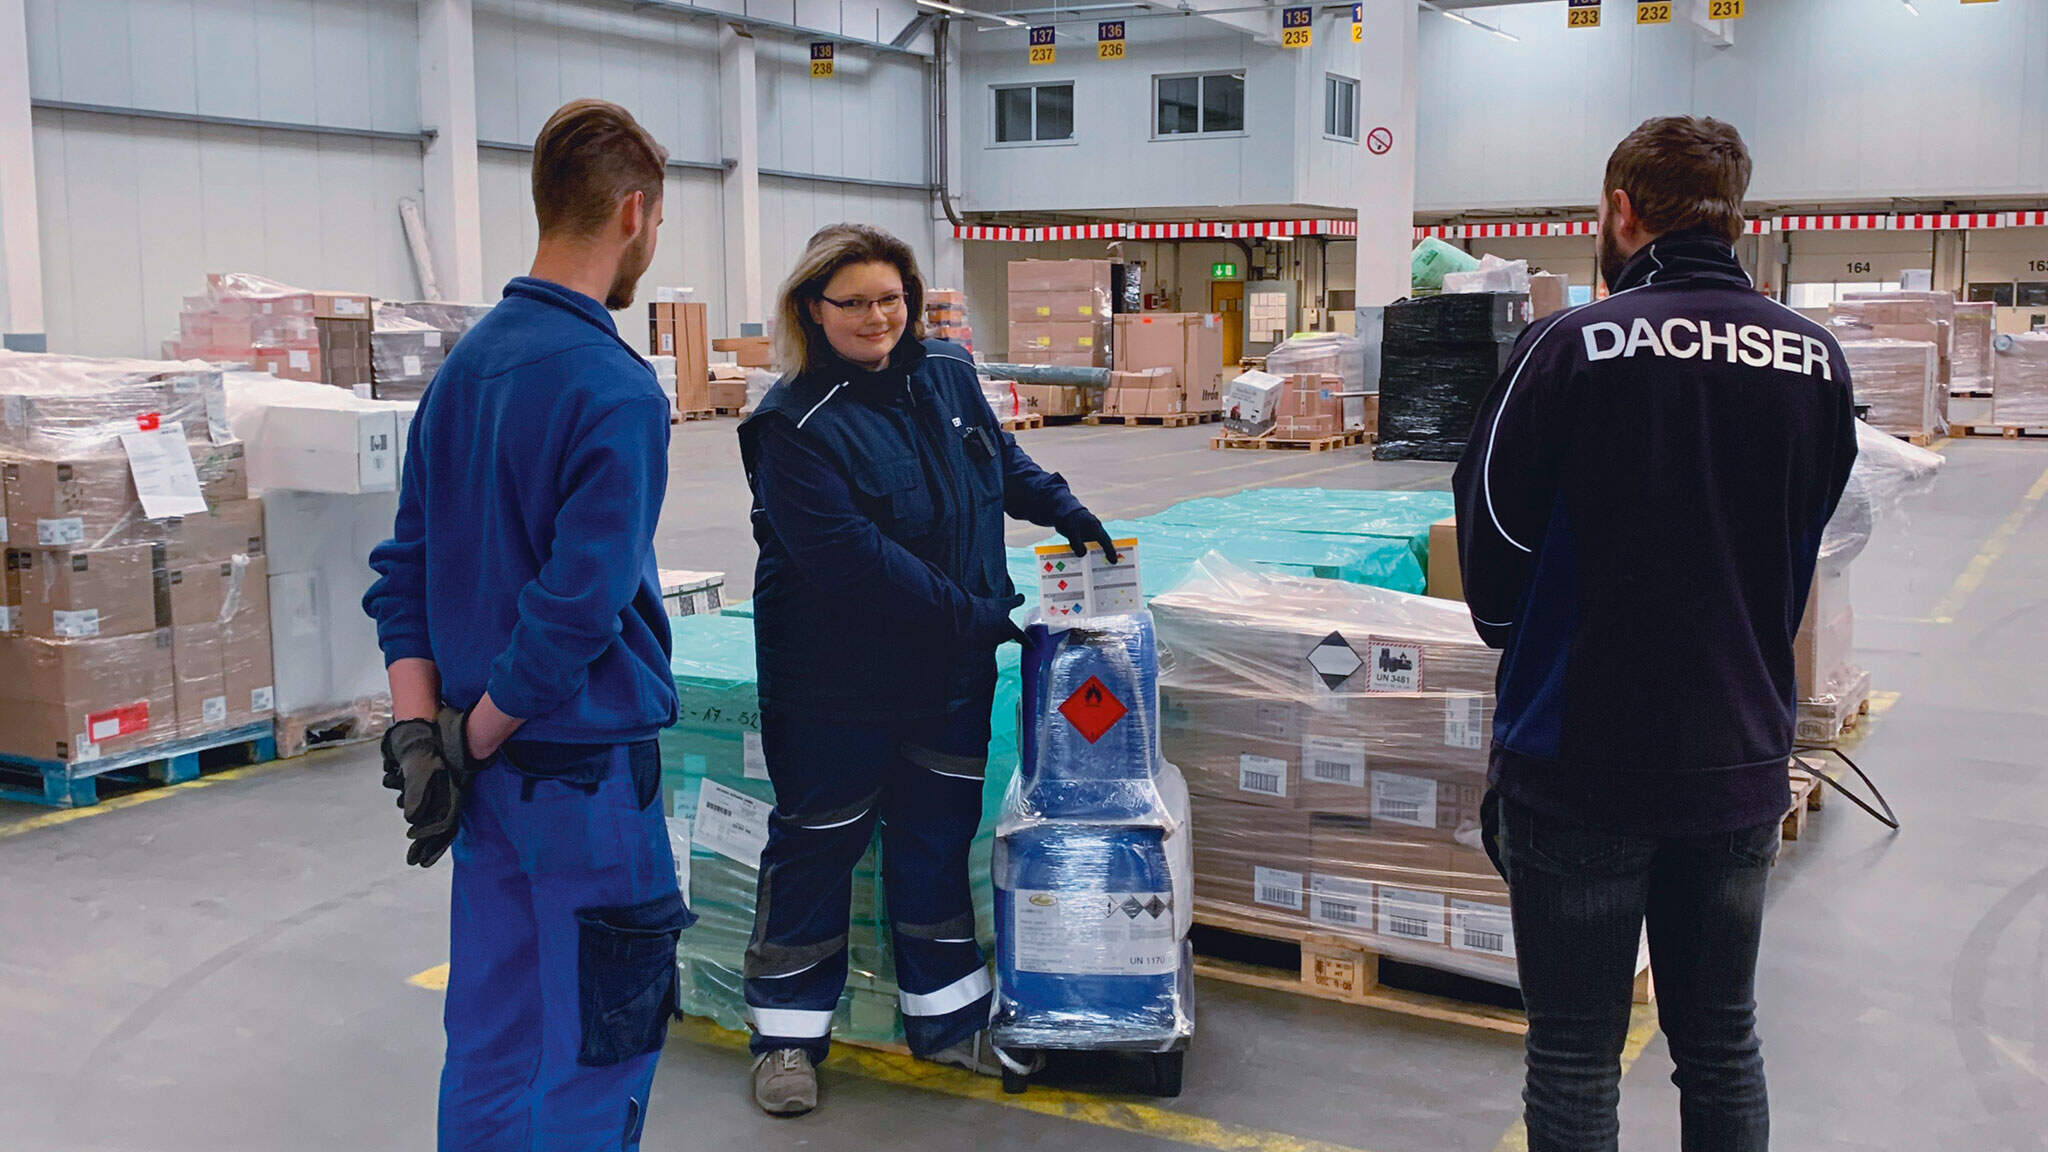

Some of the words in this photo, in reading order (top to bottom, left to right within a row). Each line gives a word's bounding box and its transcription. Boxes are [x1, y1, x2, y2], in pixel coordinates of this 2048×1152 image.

[1640, 6, 1668, 21] 232
[1713, 1, 1740, 16] 231
[1285, 11, 1309, 25] 135
[1571, 10, 1598, 25] 233
[1032, 29, 1053, 43] 137
[1101, 24, 1123, 38] 136
[1284, 30, 1309, 45] 235
[813, 45, 832, 58] 138
[1032, 48, 1053, 61] 237
[1101, 44, 1123, 57] 236
[813, 63, 832, 75] 238
[1847, 262, 1871, 273] 164
[2028, 260, 2048, 272] 16
[1581, 318, 1832, 381] DACHSER
[1129, 956, 1143, 965] UN
